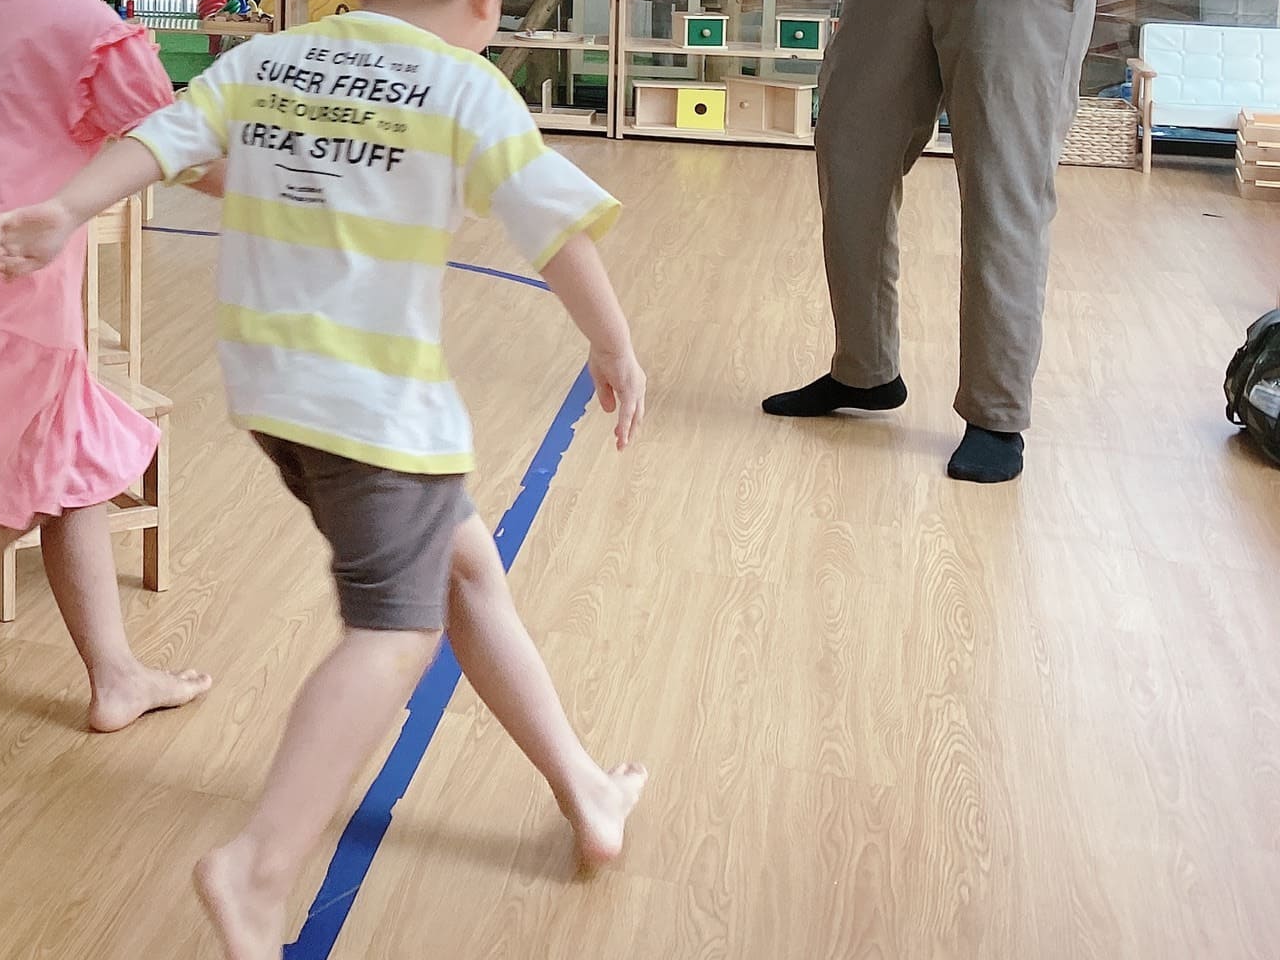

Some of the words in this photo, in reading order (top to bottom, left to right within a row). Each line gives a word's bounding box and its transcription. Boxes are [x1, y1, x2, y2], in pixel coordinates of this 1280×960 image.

[331, 51, 385, 69] CHILL
[256, 59, 325, 95] SUPER
[330, 75, 431, 108] FRESH
[310, 137, 405, 172] STUFF
